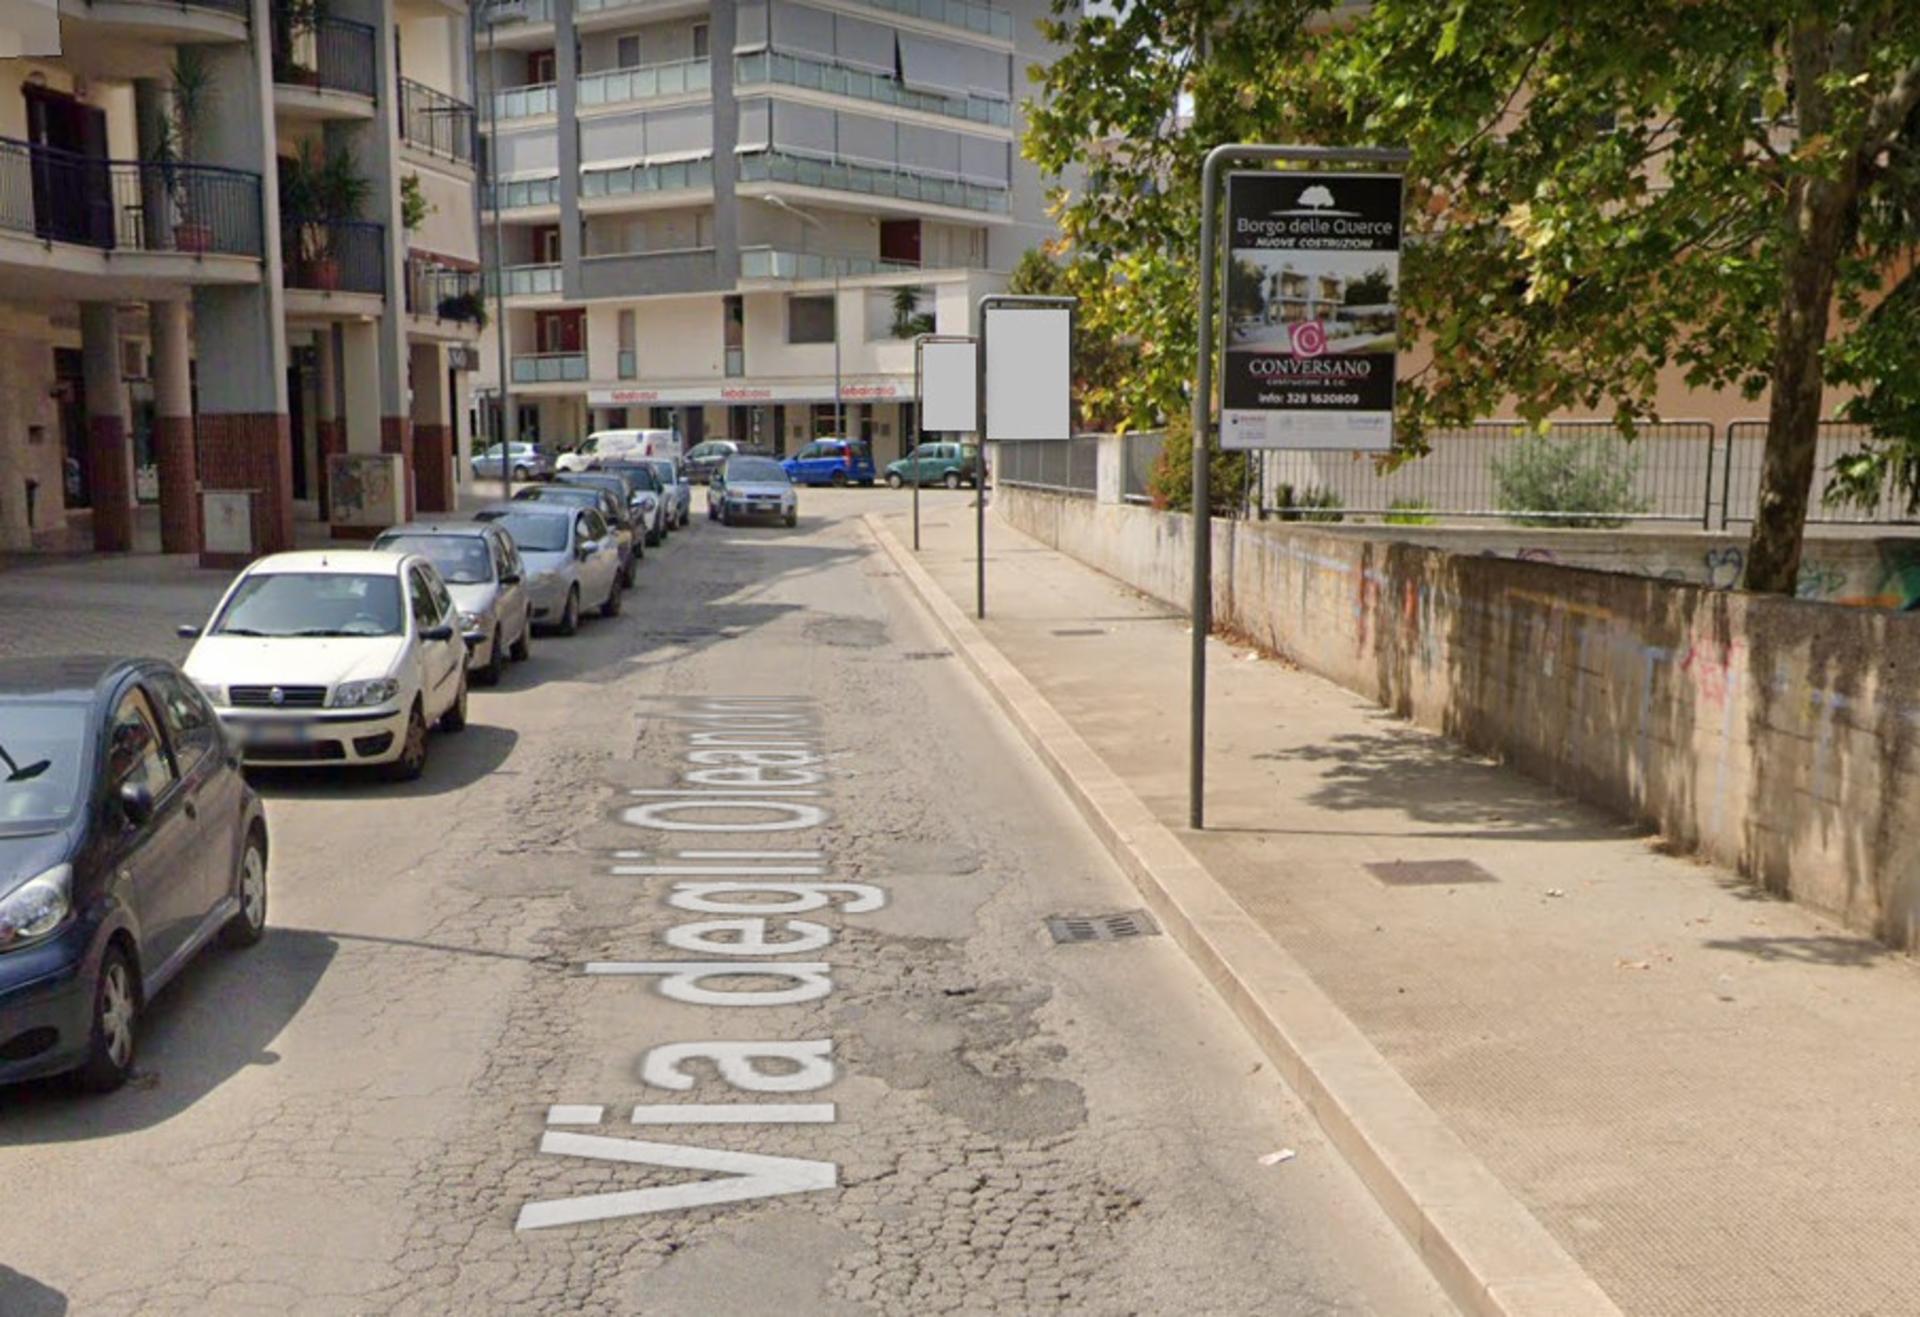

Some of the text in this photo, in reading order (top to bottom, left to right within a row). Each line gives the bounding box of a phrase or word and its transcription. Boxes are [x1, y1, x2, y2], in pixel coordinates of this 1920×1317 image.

[1236, 217, 1393, 236] Borgo delle Querce
[1255, 237, 1374, 248] NUOVE COSTRUZIONI
[1249, 359, 1371, 375] CONVERSANO
